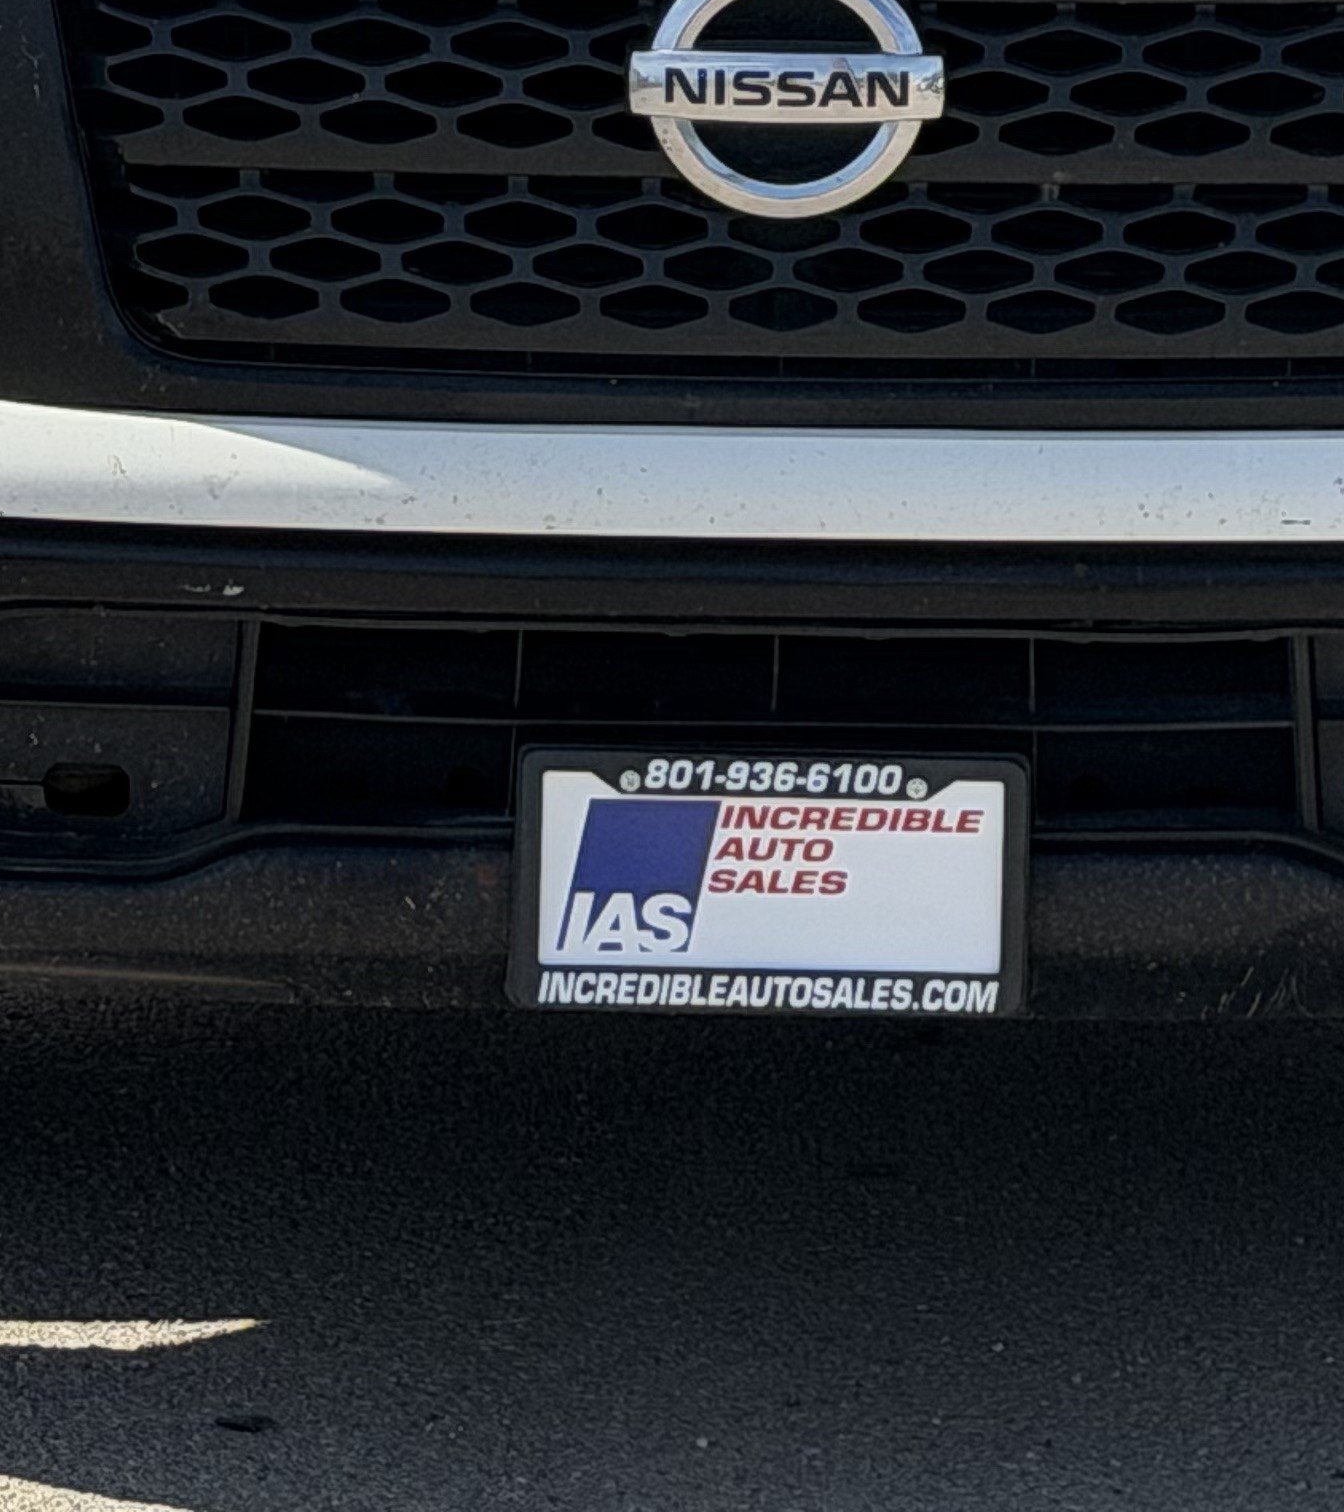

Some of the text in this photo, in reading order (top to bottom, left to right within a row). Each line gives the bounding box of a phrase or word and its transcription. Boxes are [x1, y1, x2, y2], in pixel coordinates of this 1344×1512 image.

[663, 66, 910, 108] NISSAN
[644, 758, 904, 795] 801-936-6100
[720, 804, 986, 834] INCREDIBLE
[714, 837, 834, 863] AUTO
[707, 869, 850, 896] SALES
[562, 889, 693, 954] IAS
[537, 970, 999, 1014] INCREDIBLEAUTOSALES.COM
